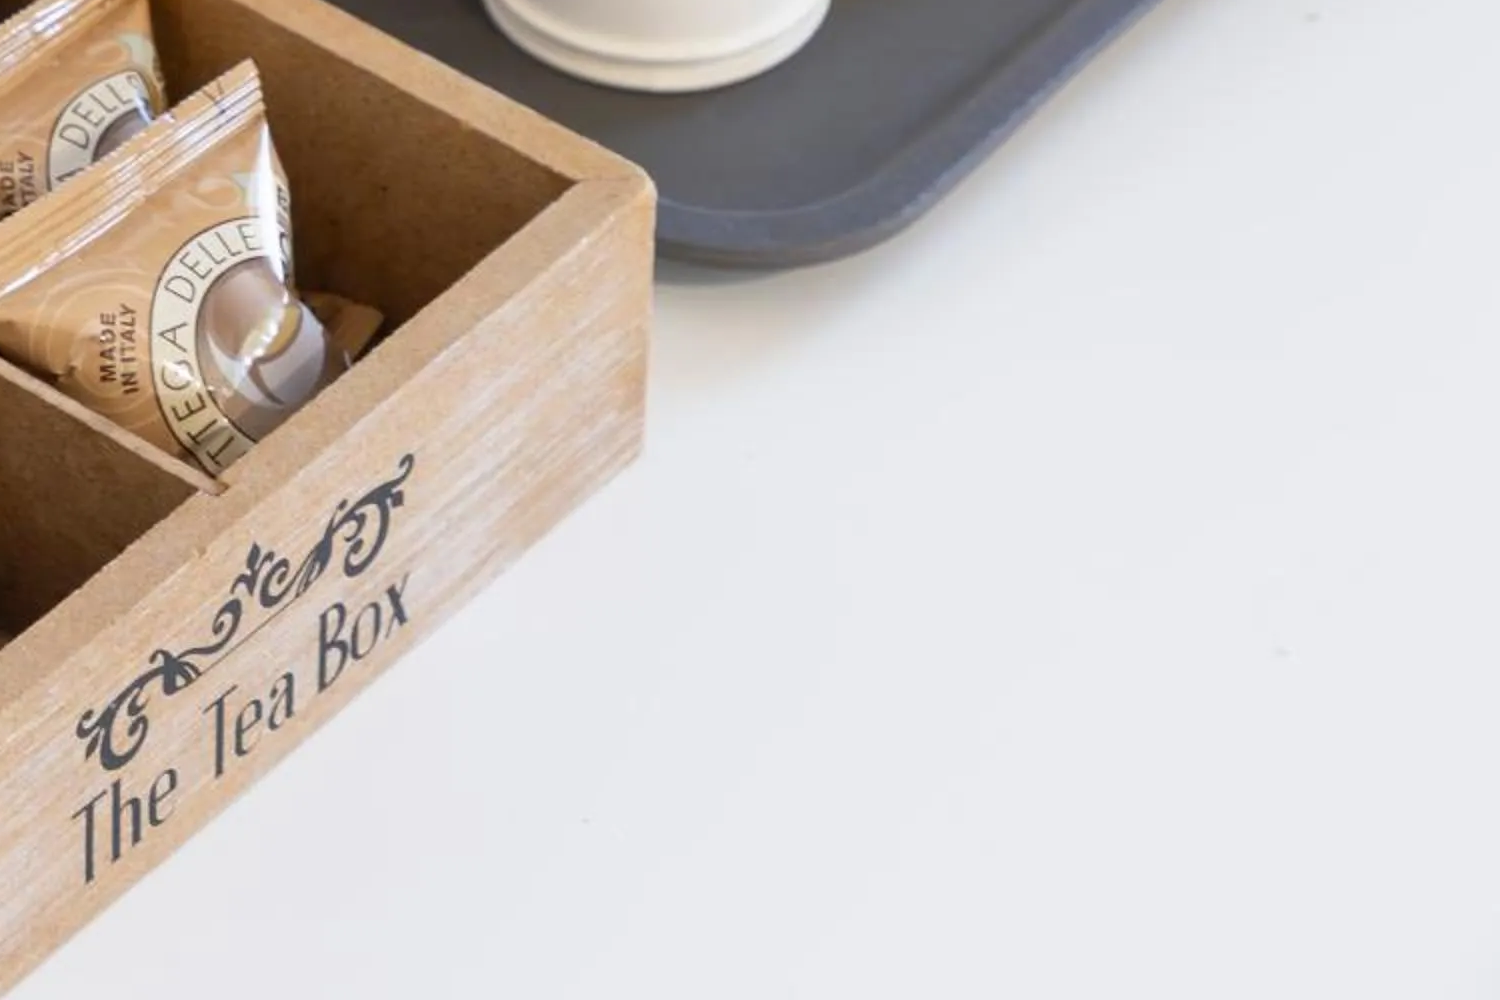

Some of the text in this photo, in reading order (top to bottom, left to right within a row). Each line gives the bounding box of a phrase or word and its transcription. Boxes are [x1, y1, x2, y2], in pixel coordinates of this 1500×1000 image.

[99, 311, 119, 385] MADE
[118, 302, 140, 396] IN ITALY
[158, 220, 263, 468] TTEGA DELLE
[70, 573, 410, 885] The Tea Box
